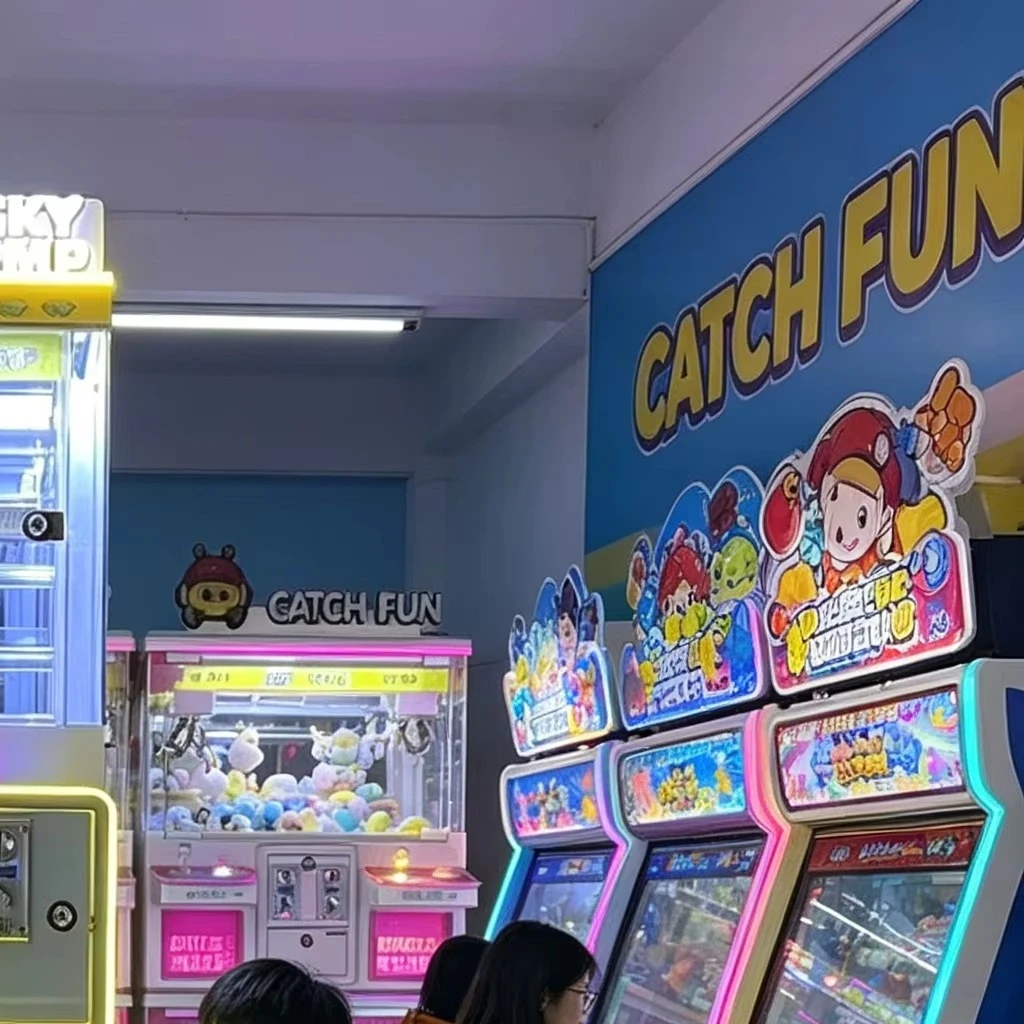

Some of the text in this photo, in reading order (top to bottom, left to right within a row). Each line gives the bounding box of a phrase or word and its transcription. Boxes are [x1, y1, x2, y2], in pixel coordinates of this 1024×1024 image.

[634, 75, 1024, 453] CATCH FUN
[267, 589, 443, 627] CATCH FUN
